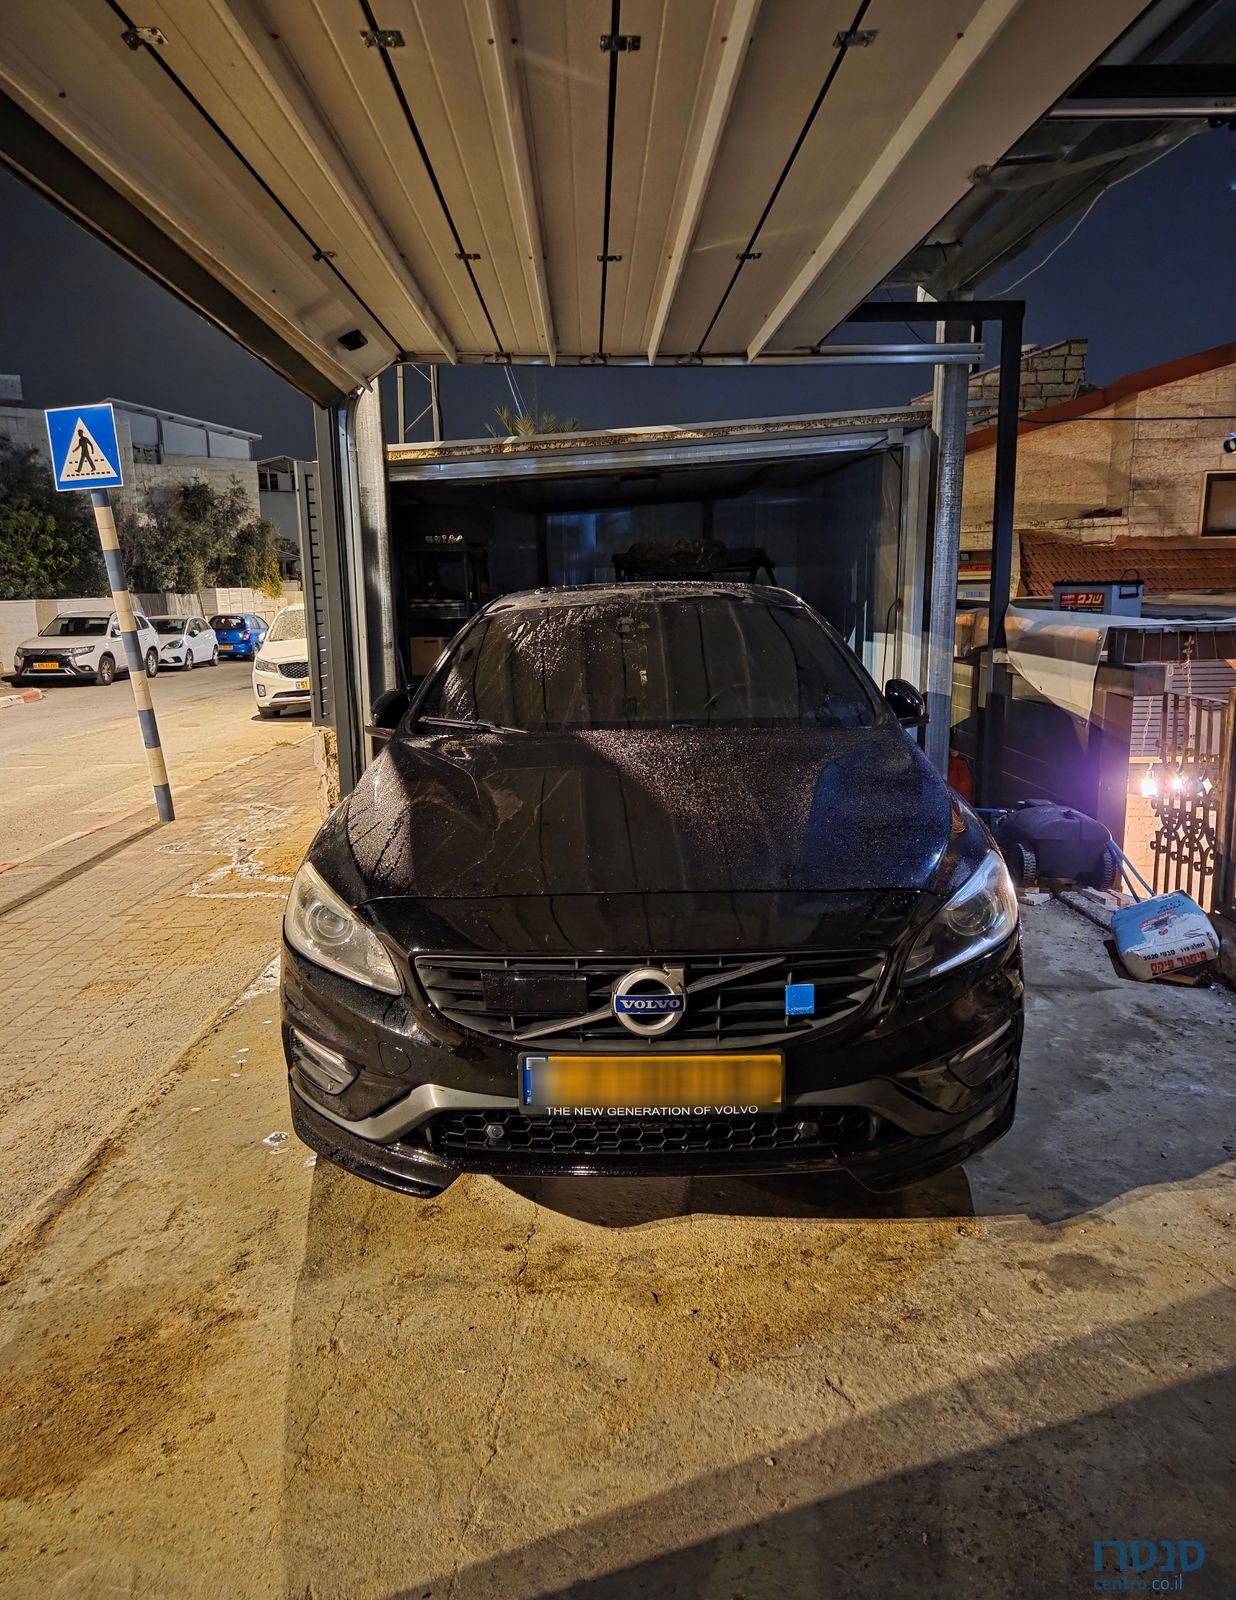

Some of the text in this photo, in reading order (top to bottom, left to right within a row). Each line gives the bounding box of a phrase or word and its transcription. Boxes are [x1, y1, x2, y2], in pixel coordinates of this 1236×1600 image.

[619, 999, 681, 1009] VOLVO
[545, 1105, 759, 1116] THE NEW GENERATION OF VOLVO
